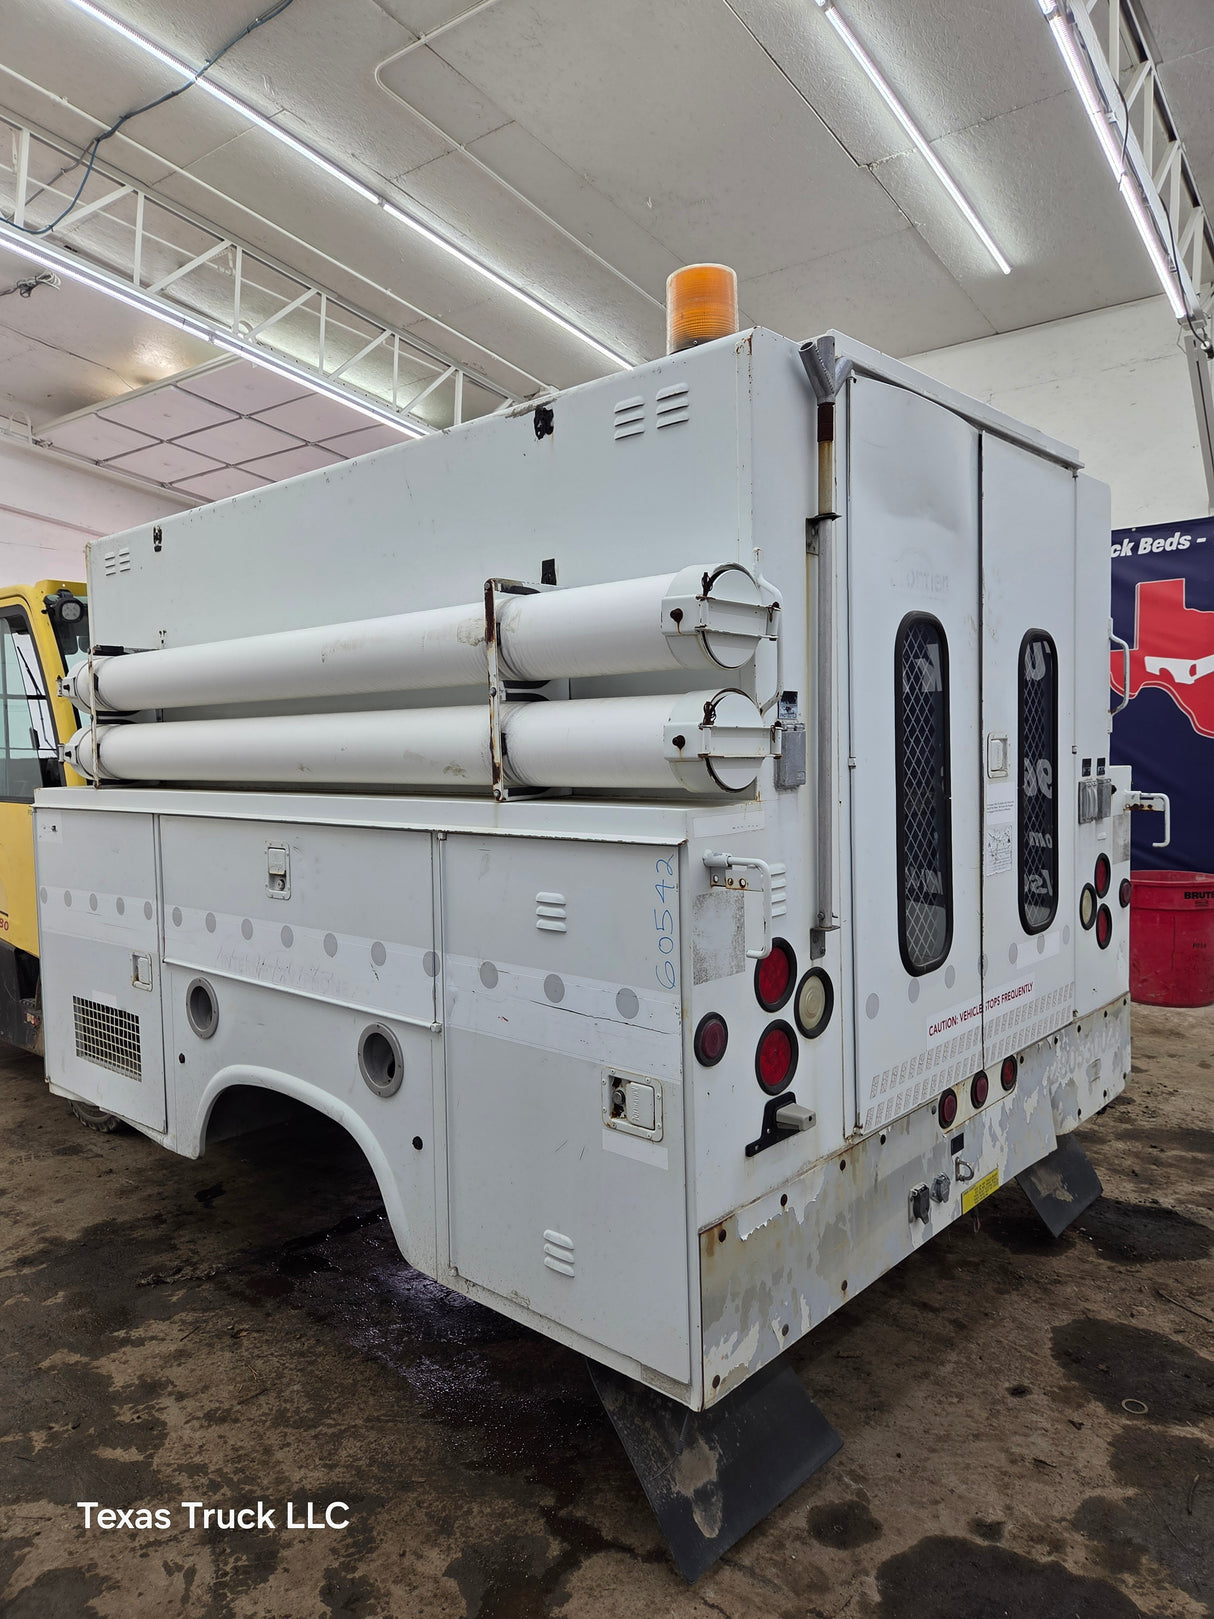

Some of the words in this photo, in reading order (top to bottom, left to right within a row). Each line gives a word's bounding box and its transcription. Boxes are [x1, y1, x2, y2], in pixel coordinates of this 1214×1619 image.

[1138, 532, 1192, 555] Beds
[653, 854, 676, 990] 60542
[928, 1015, 958, 1036] CAUTION:
[960, 1004, 983, 1022] VEHICLE
[1001, 982, 1033, 1003] FREQUENTLY
